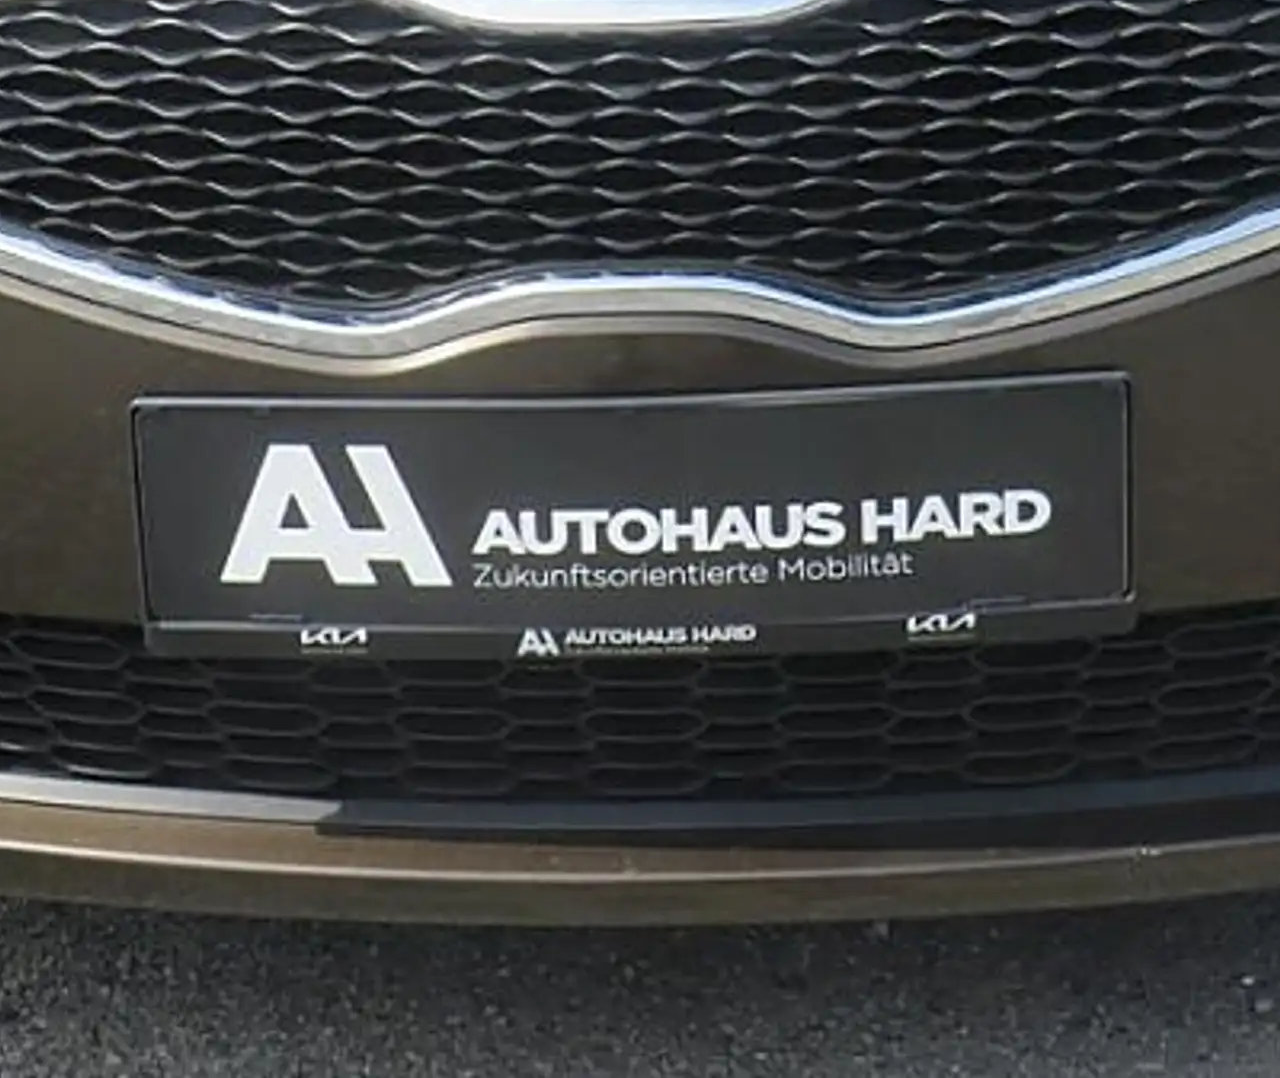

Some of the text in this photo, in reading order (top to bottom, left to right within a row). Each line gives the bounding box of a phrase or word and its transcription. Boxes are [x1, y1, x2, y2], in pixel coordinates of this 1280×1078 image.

[471, 488, 1053, 556] AUTOHAUS HARD
[472, 550, 915, 590] Zukunftsorientierte Mobilität
[565, 625, 687, 644] AUTOHAUS
[691, 623, 758, 642] HARD
